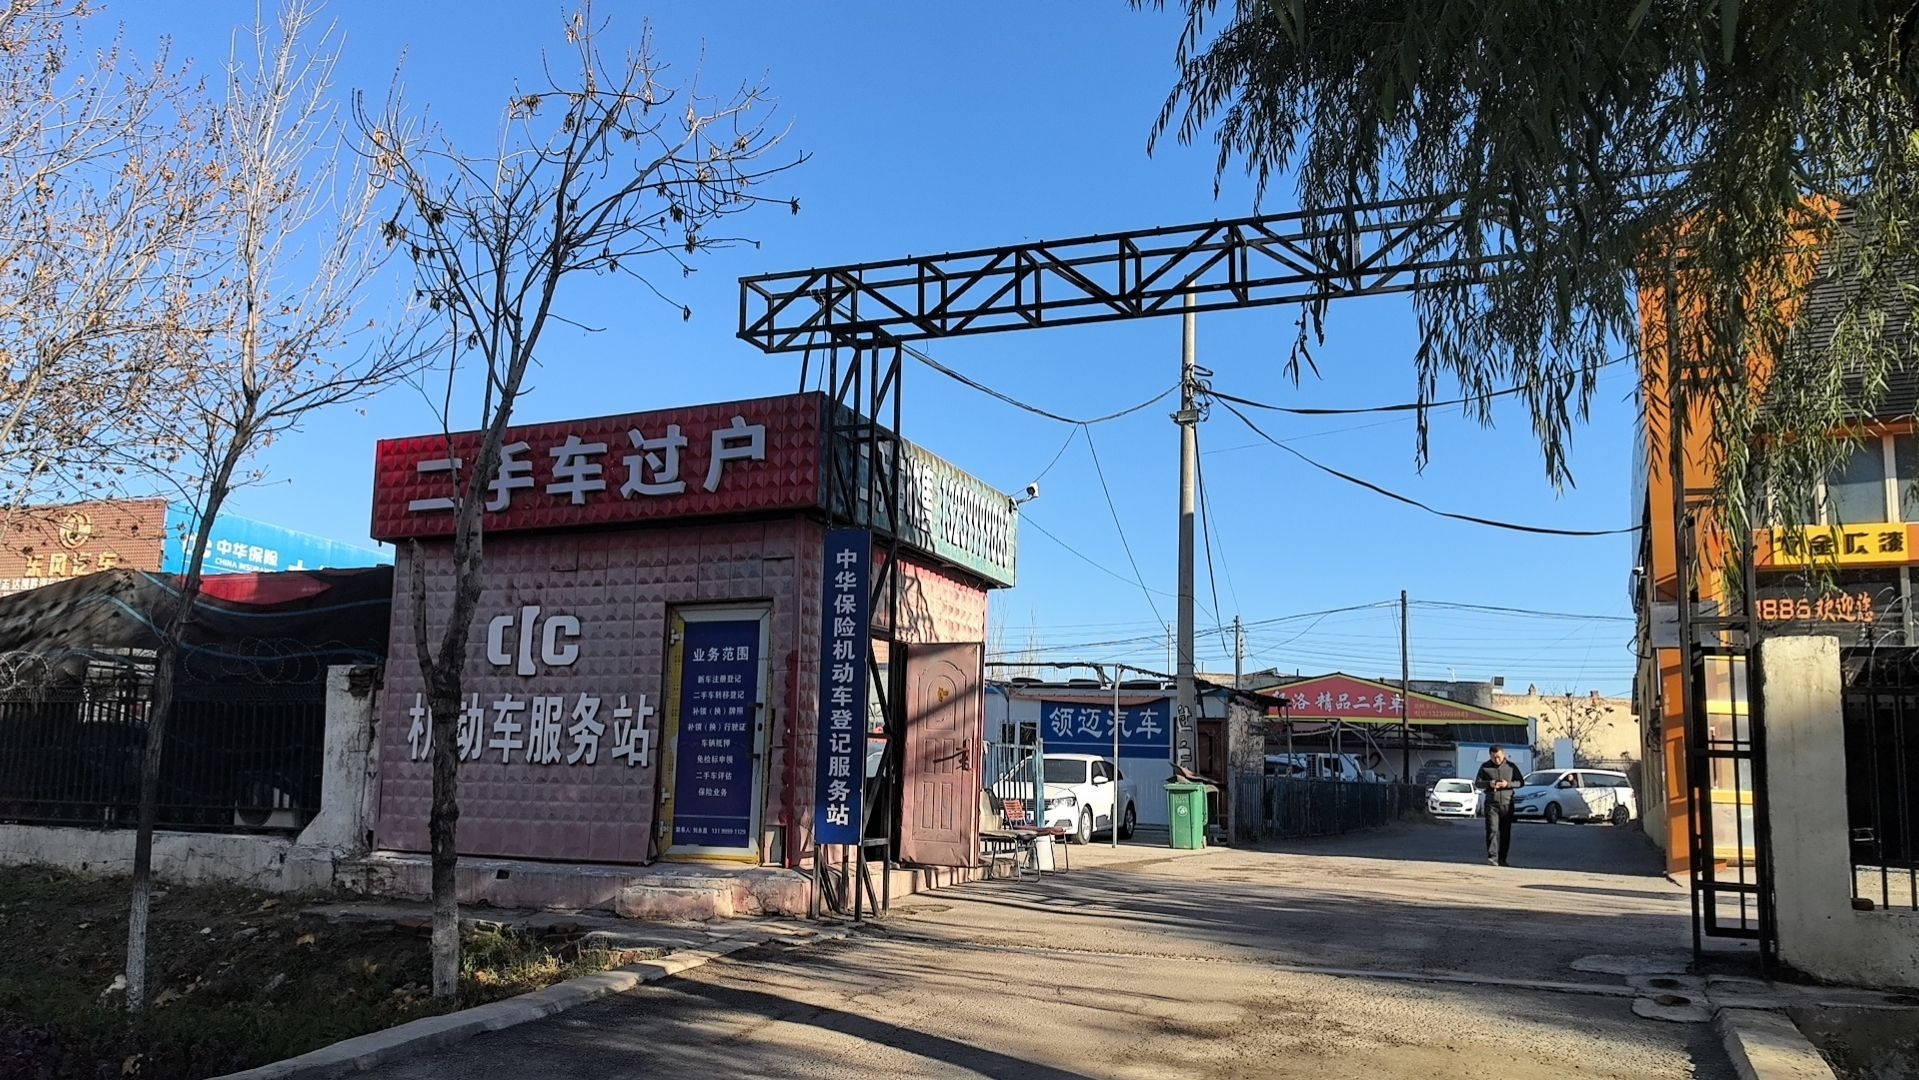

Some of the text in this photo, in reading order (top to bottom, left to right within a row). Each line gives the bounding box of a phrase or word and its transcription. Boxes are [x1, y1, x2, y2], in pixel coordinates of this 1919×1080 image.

[408, 415, 766, 512] 二手车过户
[24, 551, 118, 577] 东风汽车
[216, 539, 279, 567] 中华保险
[692, 646, 750, 662] 业务范围
[697, 675, 742, 684] 新车注册登记
[826, 548, 858, 826] 中华保险机动车登记服务站
[407, 692, 655, 768] 机动车服务站
[1049, 706, 1163, 739] 领迈汽车
[695, 771, 733, 781] 二手车评估
[698, 787, 728, 797] 保险业务
